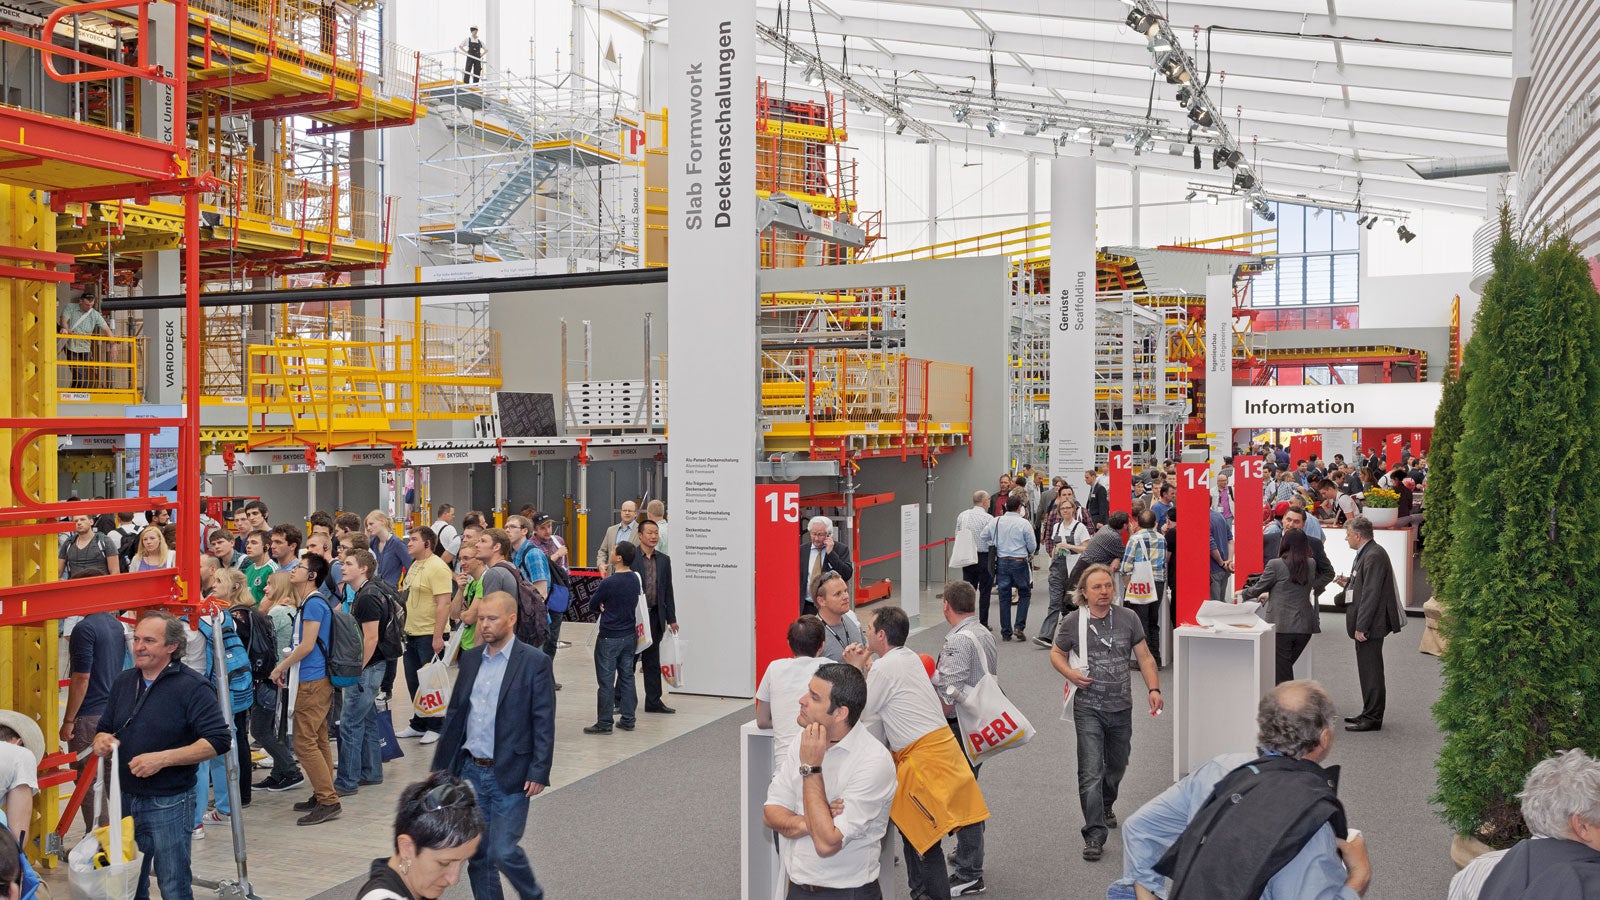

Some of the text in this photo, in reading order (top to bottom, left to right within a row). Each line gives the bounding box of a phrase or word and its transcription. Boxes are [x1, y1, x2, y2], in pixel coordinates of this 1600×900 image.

[163, 71, 174, 122] Unterzg
[714, 21, 735, 228] Deckenschalungen
[686, 62, 703, 230] Slab Formwork
[1059, 289, 1069, 331] Gerüste
[1075, 271, 1086, 331] Scaffolding
[165, 320, 174, 388] VARIODECK
[1245, 398, 1355, 415] Information
[1113, 454, 1132, 469] 12
[1183, 467, 1210, 490] 14
[1240, 459, 1264, 479] 13
[765, 492, 799, 522] 15
[969, 711, 1018, 753] PERI
